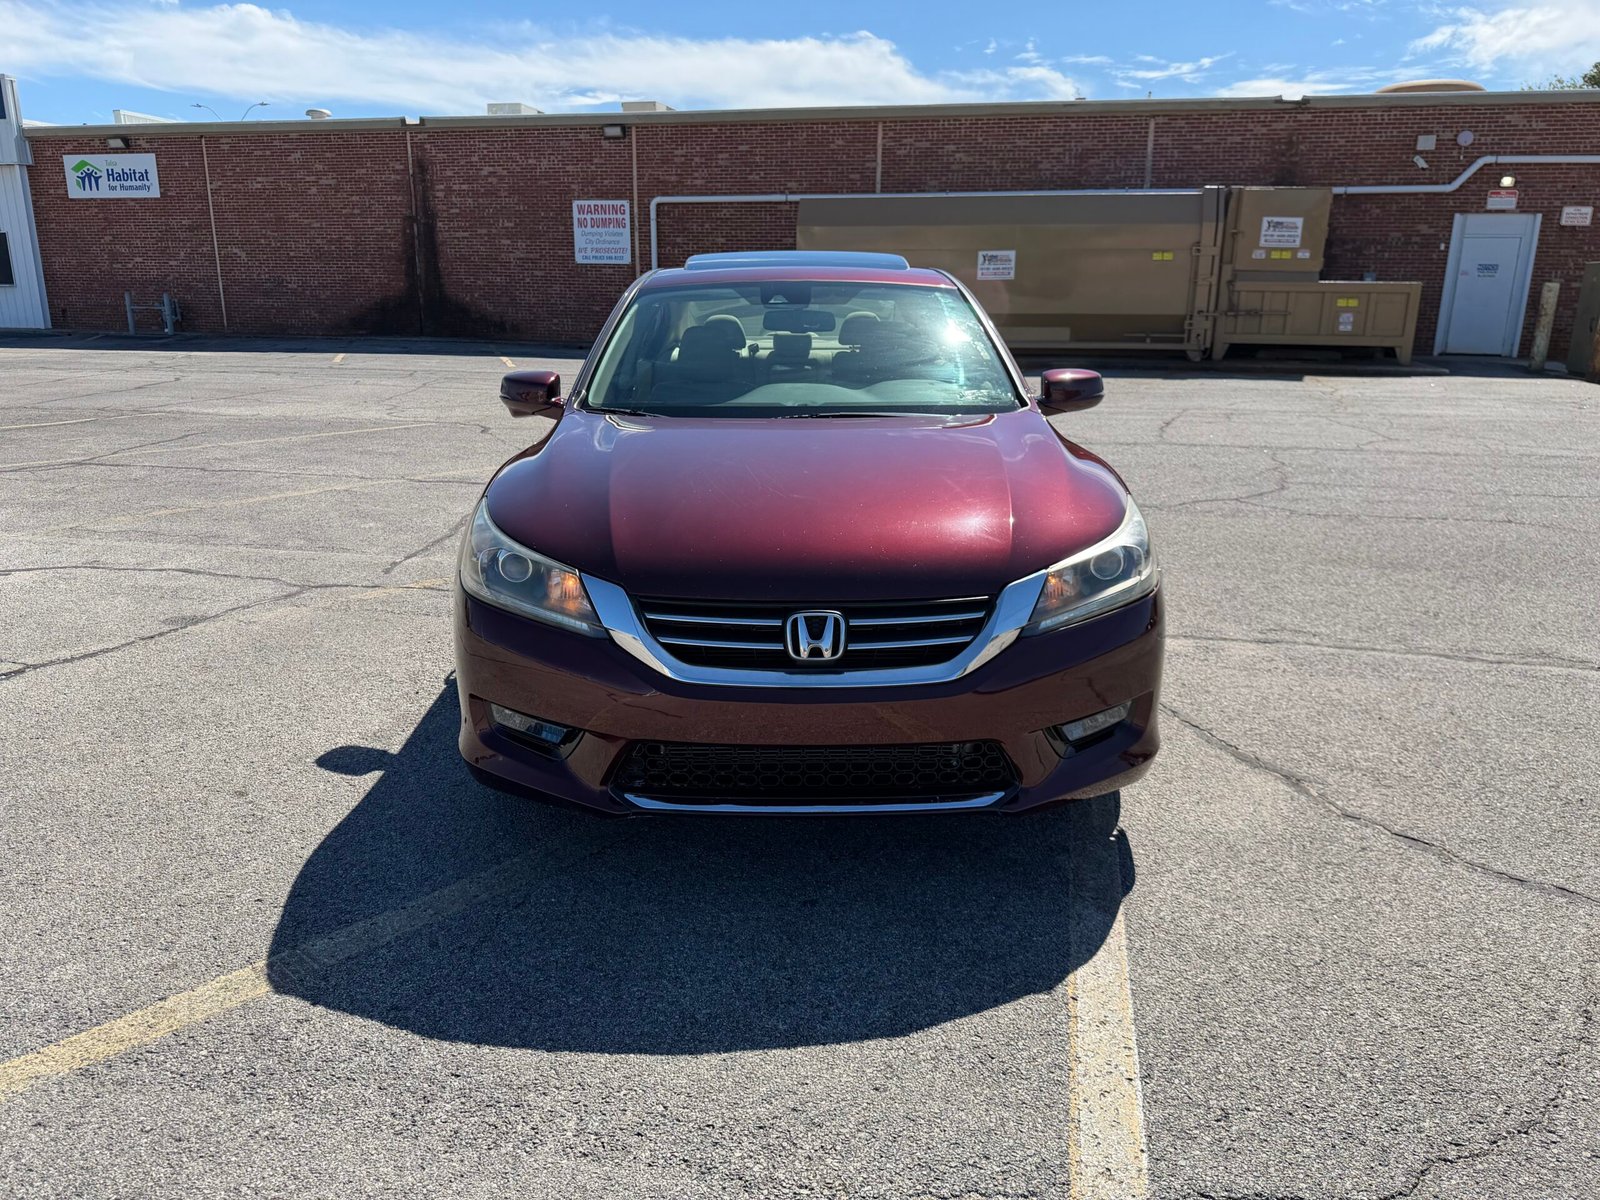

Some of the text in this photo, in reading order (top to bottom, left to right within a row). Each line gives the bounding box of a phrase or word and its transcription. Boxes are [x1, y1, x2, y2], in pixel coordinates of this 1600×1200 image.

[106, 168, 150, 182] Habitat
[108, 183, 151, 192] for Humanity
[576, 204, 626, 215] WARNING
[577, 217, 626, 229] NO DUMPING
[581, 230, 603, 238] Dumping
[590, 247, 628, 255] PROSECUTE!
